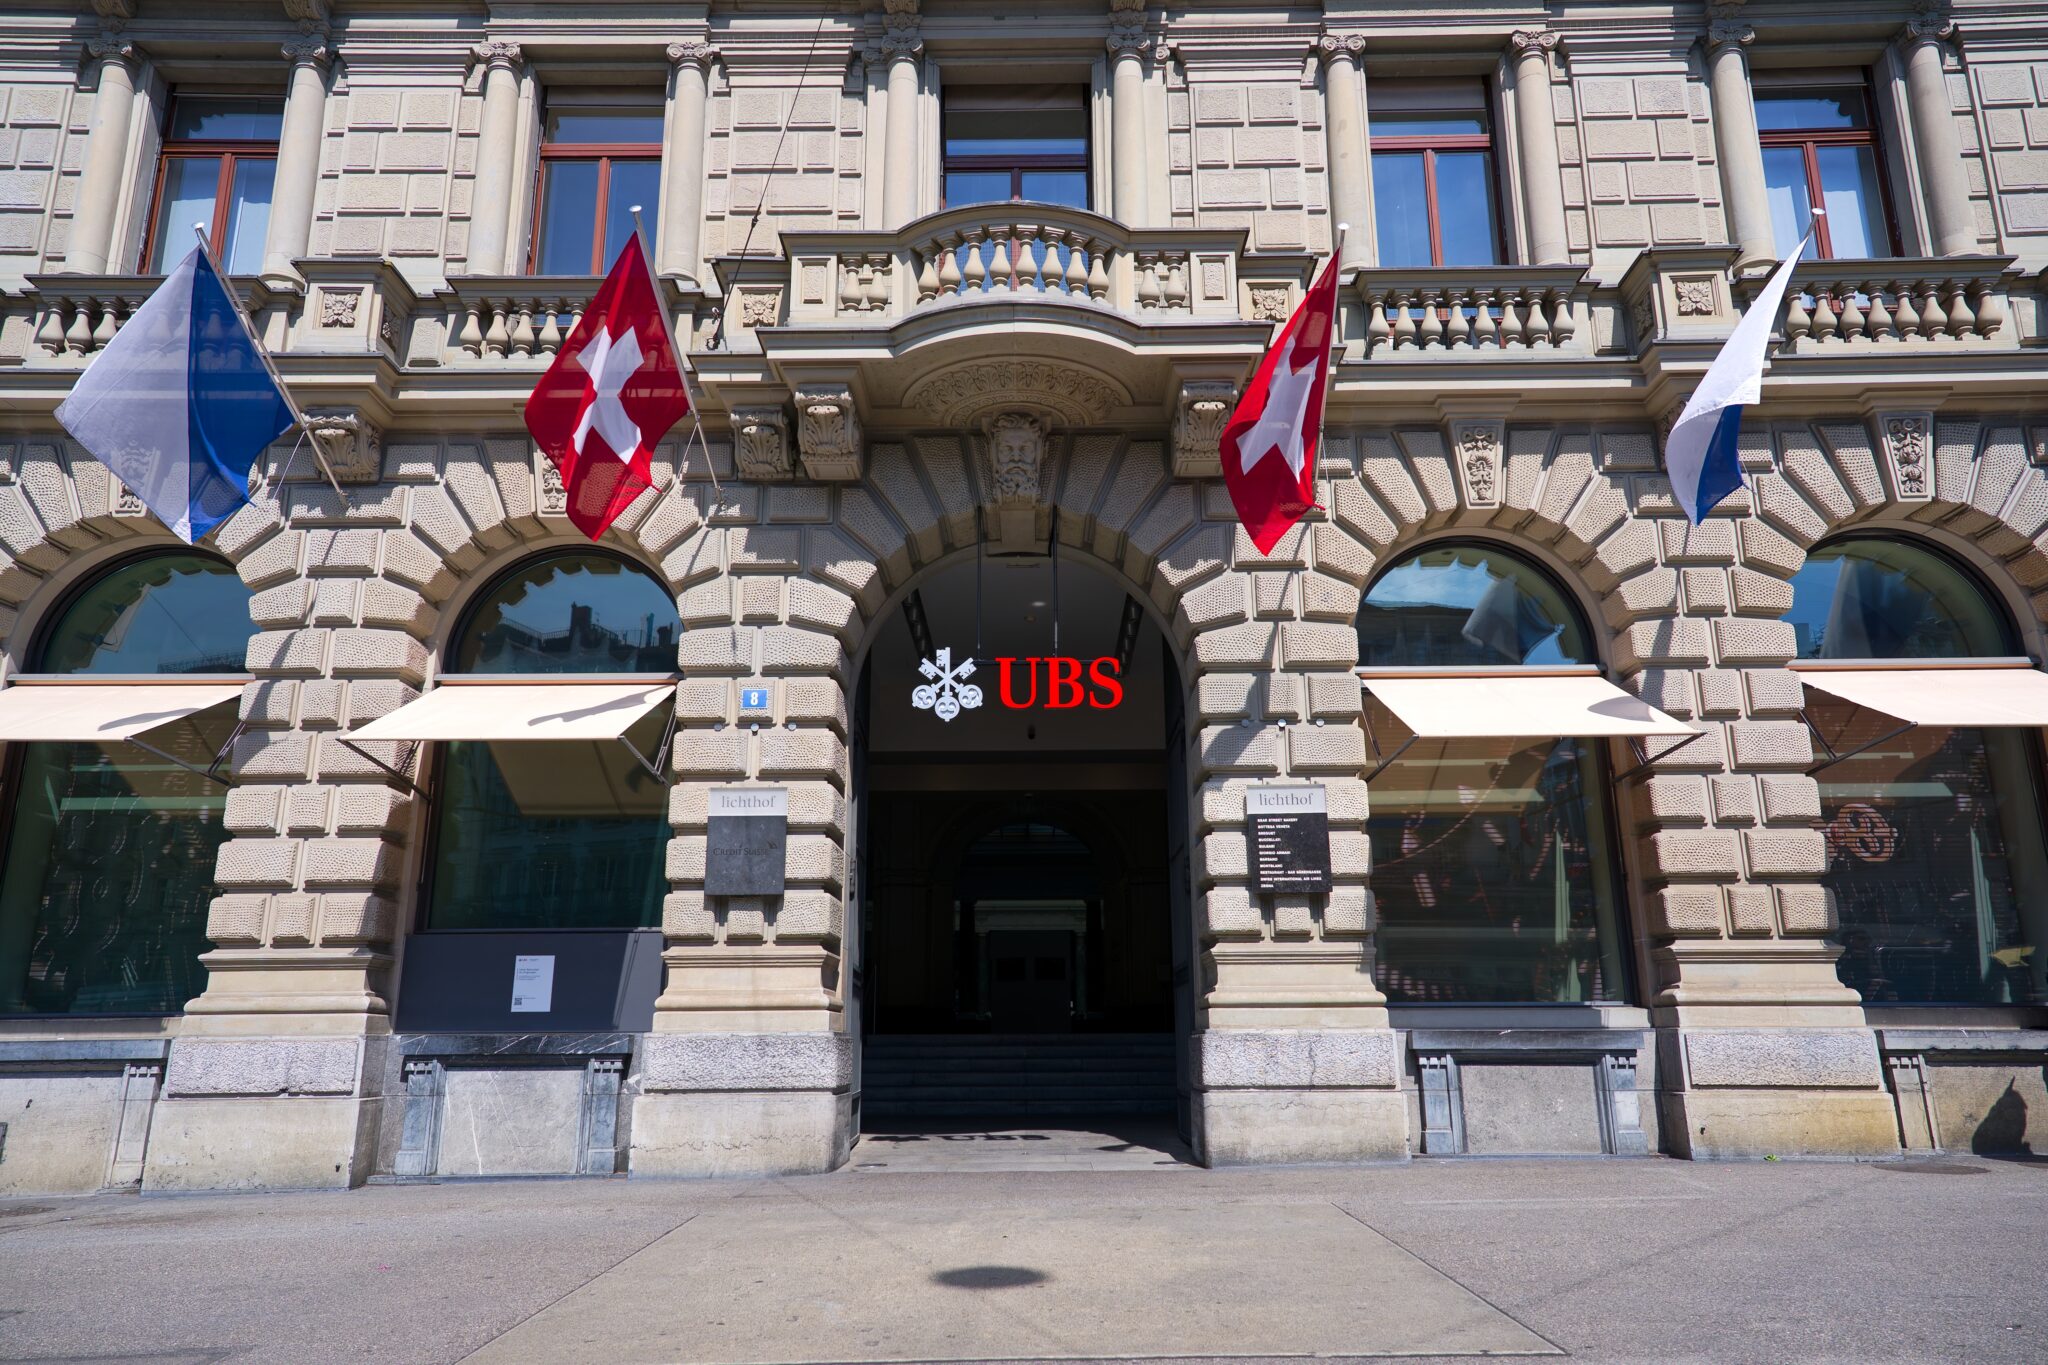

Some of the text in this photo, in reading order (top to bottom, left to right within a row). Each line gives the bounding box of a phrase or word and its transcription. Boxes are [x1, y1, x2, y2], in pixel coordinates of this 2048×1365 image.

[995, 656, 1124, 710] UBS
[750, 691, 759, 706] 8
[721, 795, 776, 808] lichthof
[1259, 793, 1314, 806] lichthof
